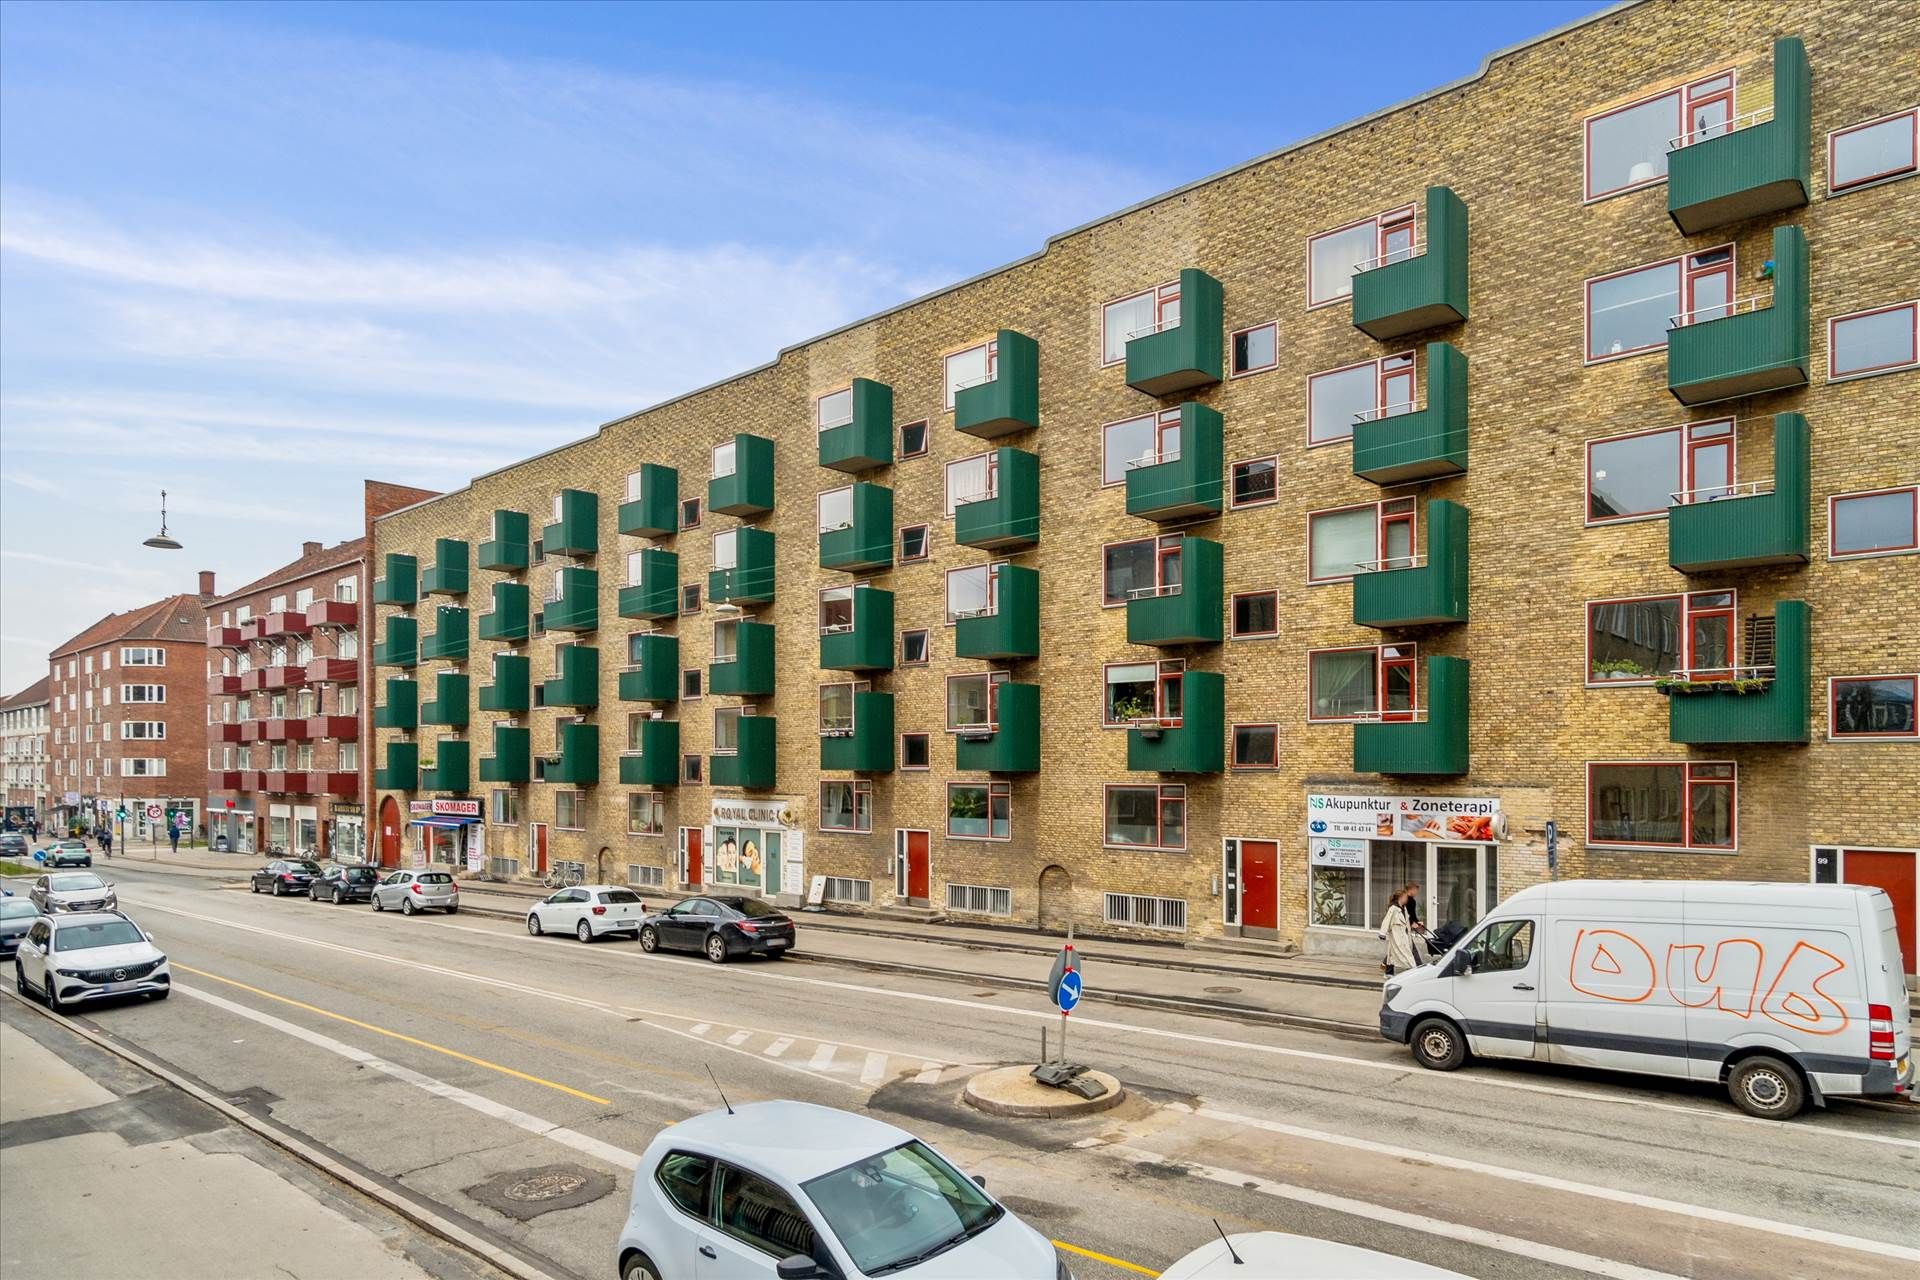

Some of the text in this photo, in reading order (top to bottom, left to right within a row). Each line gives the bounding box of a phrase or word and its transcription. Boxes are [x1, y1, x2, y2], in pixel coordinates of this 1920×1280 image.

[435, 801, 477, 813] SKOMAGER
[1325, 797, 1391, 812] Akupunktur
[1400, 801, 1408, 811] &
[1412, 799, 1492, 815] Zoneterapi
[721, 807, 774, 822] ROYAL CLINIC
[1817, 857, 1829, 865] 99
